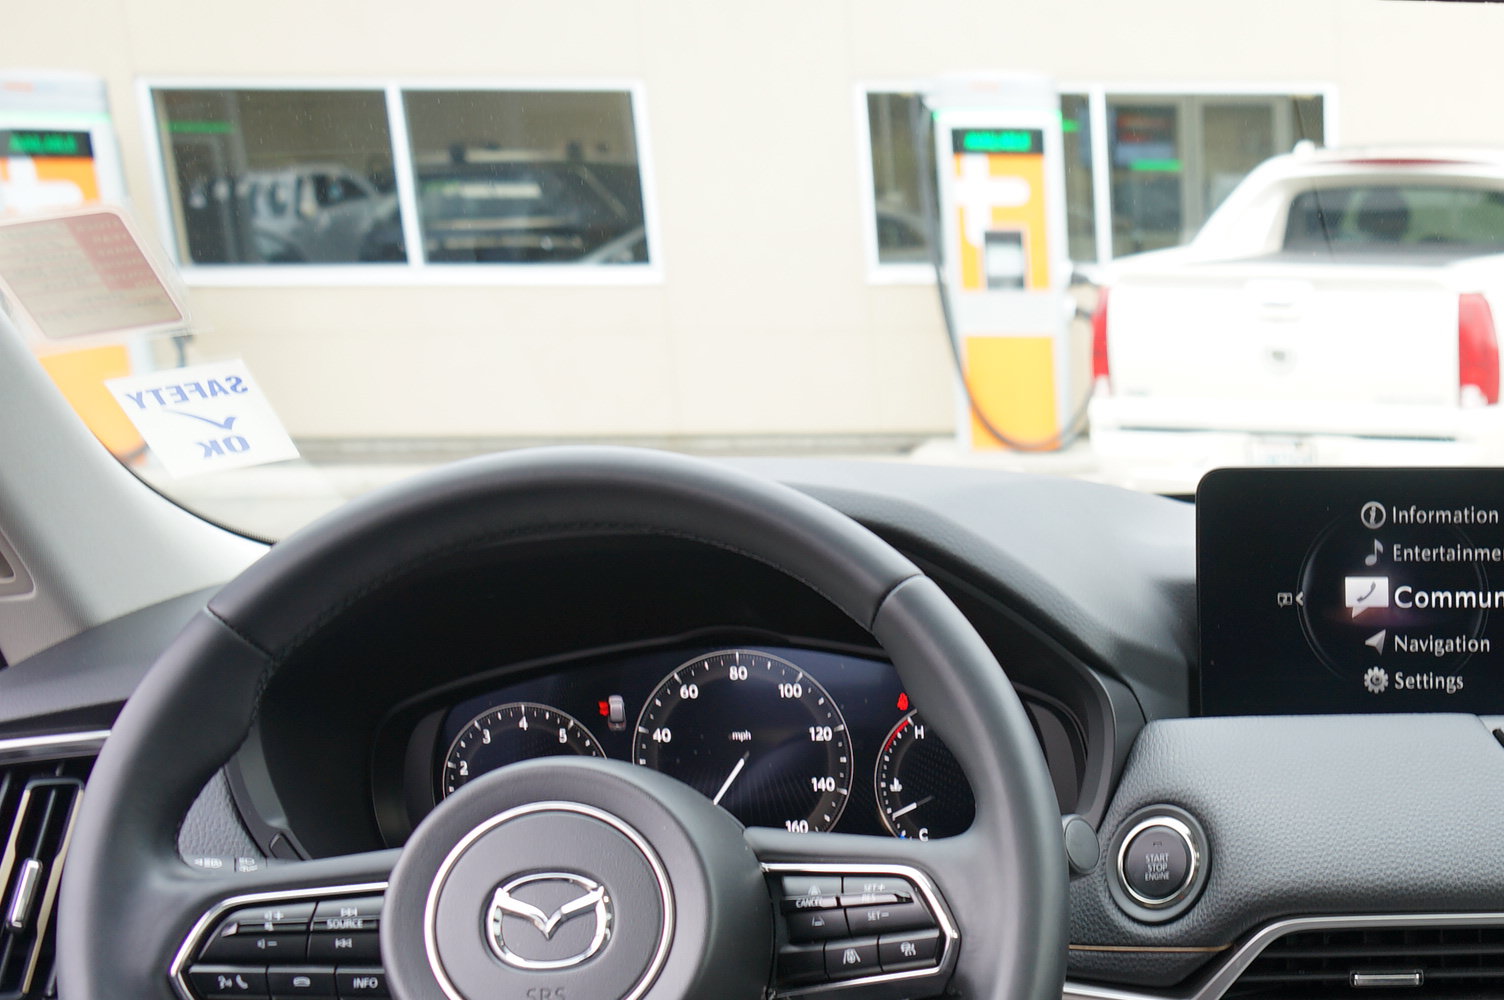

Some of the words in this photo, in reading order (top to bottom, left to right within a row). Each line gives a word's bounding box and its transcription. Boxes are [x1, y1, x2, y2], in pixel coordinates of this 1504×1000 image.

[1393, 505, 1499, 524] Information
[1394, 634, 1490, 657] Navigation
[729, 665, 748, 681] 80
[1394, 671, 1464, 694] Settings
[679, 683, 699, 699] 60
[778, 683, 803, 699] 100
[482, 729, 491, 744] 3
[558, 728, 568, 743] 5
[652, 727, 672, 743] 40
[731, 730, 751, 743] mph
[809, 726, 833, 742] 120
[914, 725, 924, 739] H
[459, 760, 469, 775] 2
[811, 776, 836, 792] 140
[785, 819, 809, 834] 160
[918, 827, 929, 841] C
[1145, 852, 1169, 863] START
[1147, 862, 1168, 872] STOP
[1145, 871, 1170, 881] ENGINE
[326, 919, 363, 930] SOURCE
[353, 977, 378, 989] INFO
